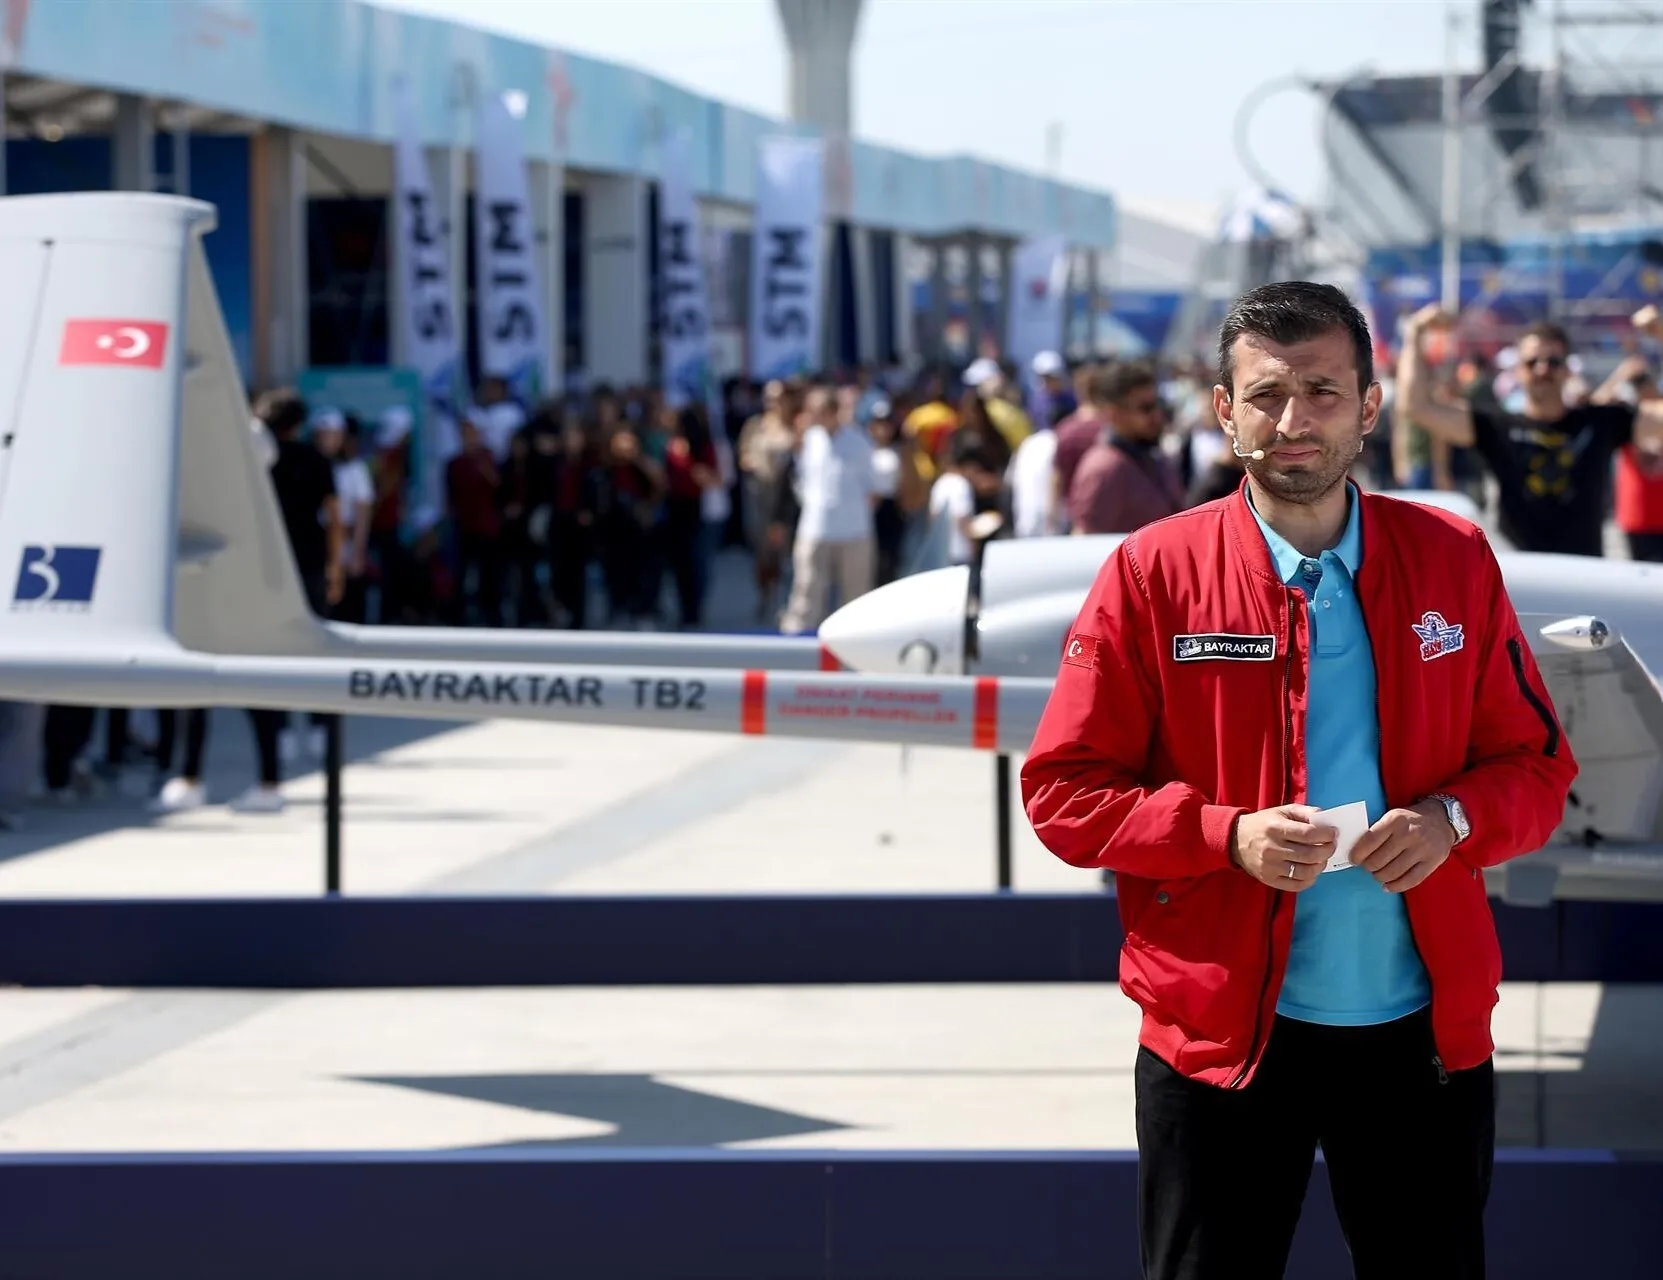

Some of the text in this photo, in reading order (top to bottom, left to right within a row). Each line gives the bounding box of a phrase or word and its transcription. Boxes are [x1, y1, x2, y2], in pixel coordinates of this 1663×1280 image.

[407, 190, 449, 340] STM
[490, 201, 535, 341] STM
[764, 227, 810, 338] STM
[349, 670, 707, 710] BAYRAKTAR TB2
[1204, 642, 1270, 654] BAYRAKTAR
